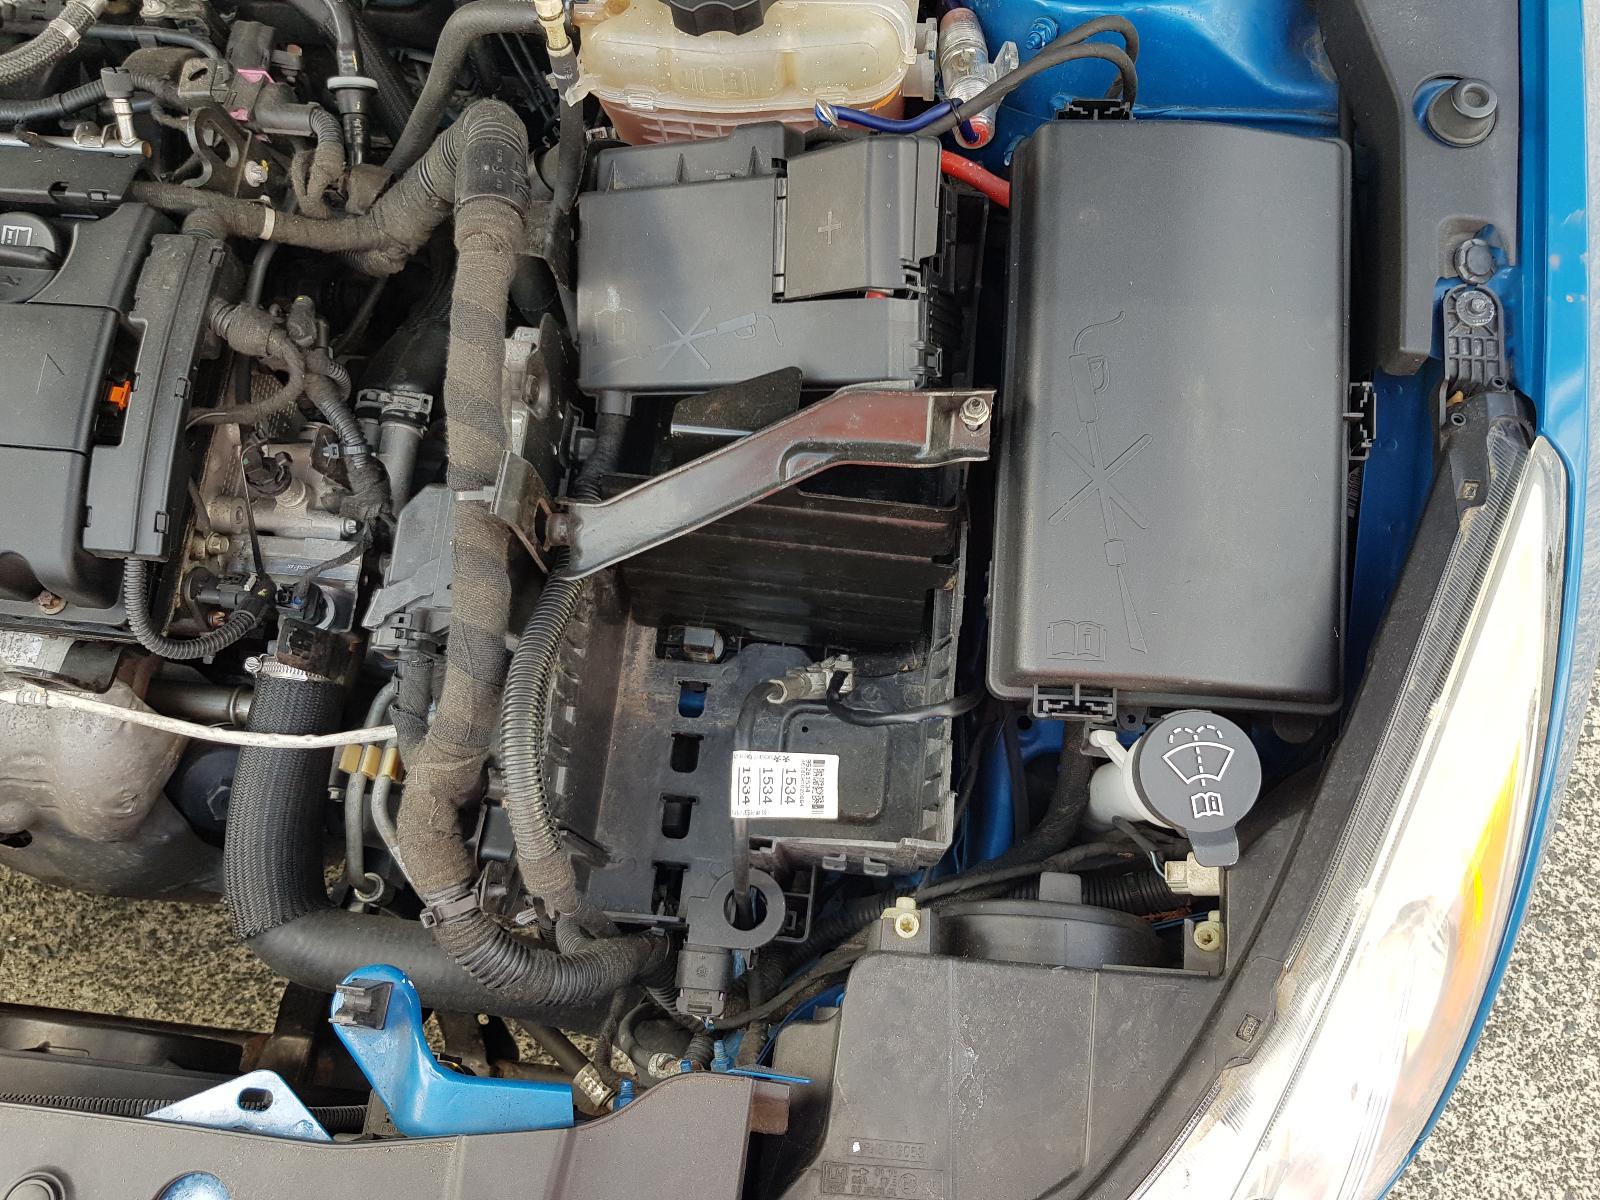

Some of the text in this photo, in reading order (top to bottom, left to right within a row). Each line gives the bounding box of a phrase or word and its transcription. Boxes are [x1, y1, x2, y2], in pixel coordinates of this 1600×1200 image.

[742, 766, 751, 805] 1534
[762, 767, 774, 805] 1534
[784, 768, 797, 805] 1534
